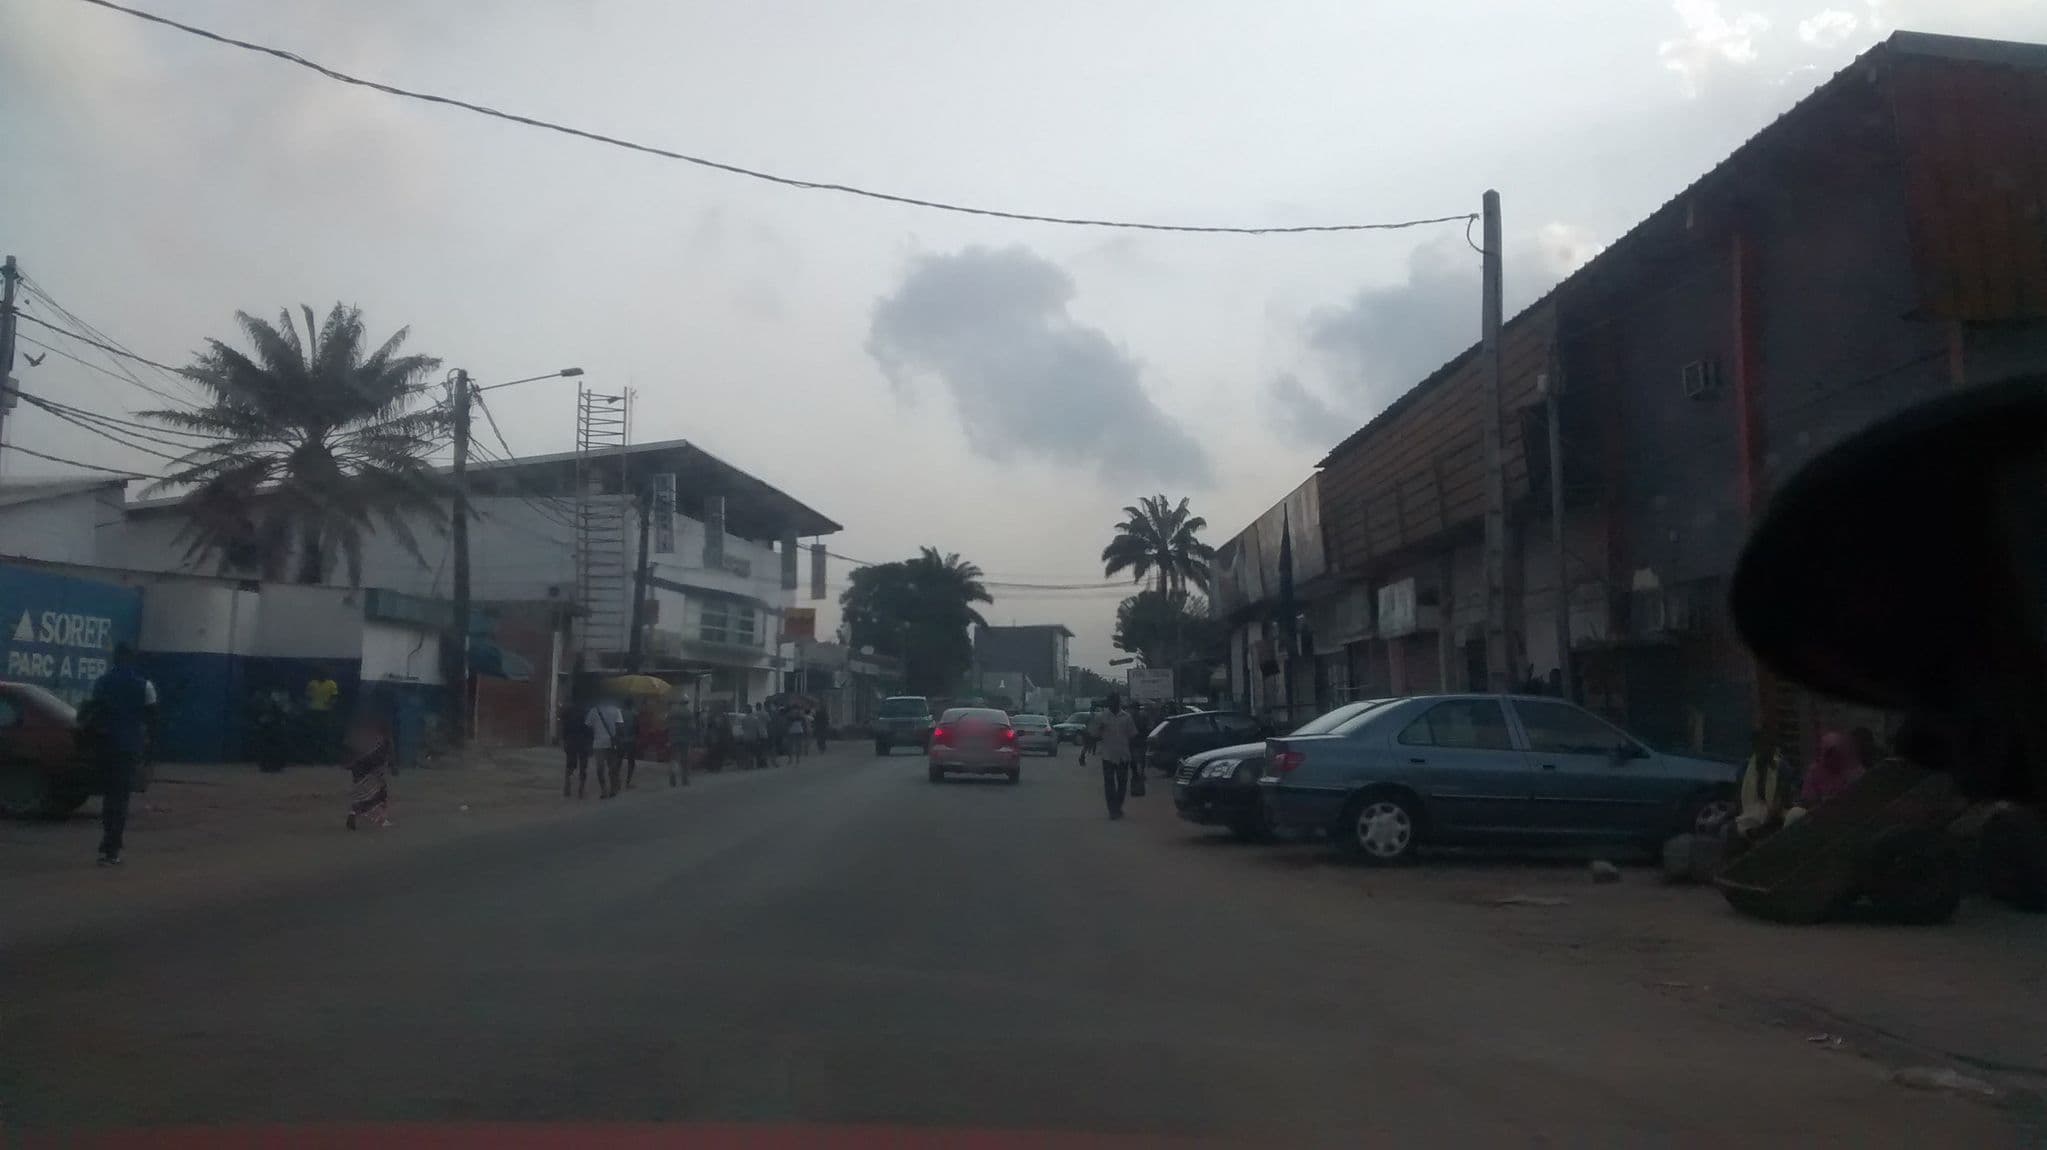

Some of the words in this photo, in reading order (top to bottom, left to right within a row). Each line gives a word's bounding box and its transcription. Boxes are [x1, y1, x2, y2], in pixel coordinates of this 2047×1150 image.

[9, 651, 54, 677] PARC
[61, 656, 72, 679] A
[79, 658, 107, 680] FER
